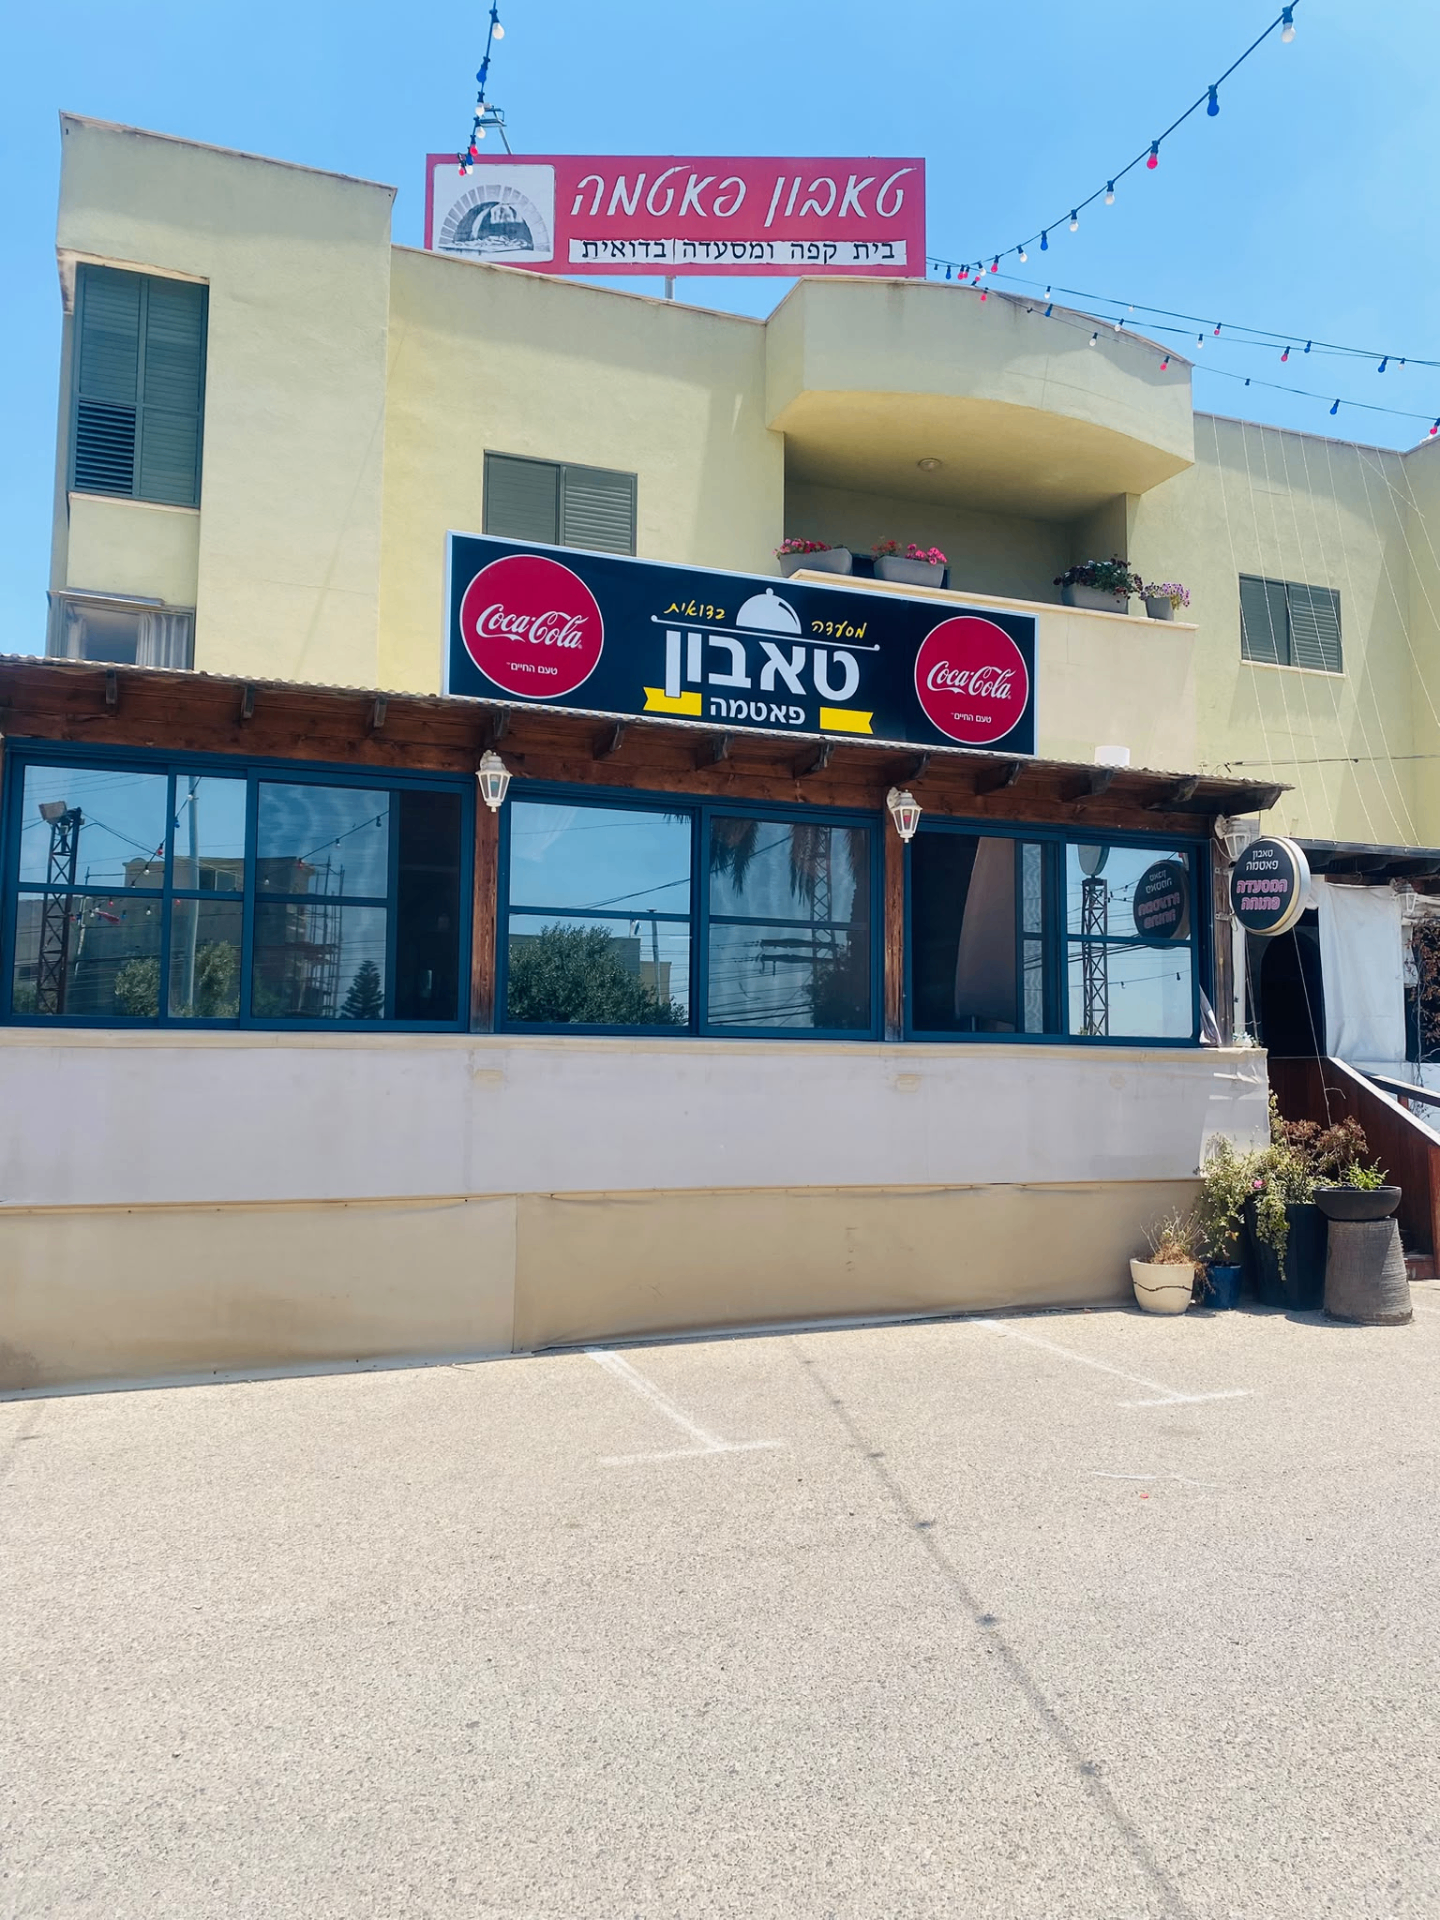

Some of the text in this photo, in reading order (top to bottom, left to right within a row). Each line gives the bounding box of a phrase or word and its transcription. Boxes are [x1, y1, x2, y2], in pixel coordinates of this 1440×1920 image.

[570, 165, 917, 227] טאבון פאטמה
[581, 240, 895, 265] בית קפה ומסעדה בדואית
[663, 599, 726, 620] בדואית
[475, 603, 590, 650] Coca-Cola
[811, 619, 868, 639] מסעדה
[537, 665, 558, 675] טעם
[664, 629, 860, 701] טאבון
[926, 660, 1017, 699] Coca-Cola
[710, 696, 806, 725] פאטמה
[975, 714, 992, 724] טעם
[1252, 849, 1274, 860] טאבון
[1245, 860, 1278, 871] פאטמה
[1236, 879, 1288, 894] המסעדה
[1241, 896, 1281, 911] פתוחה
